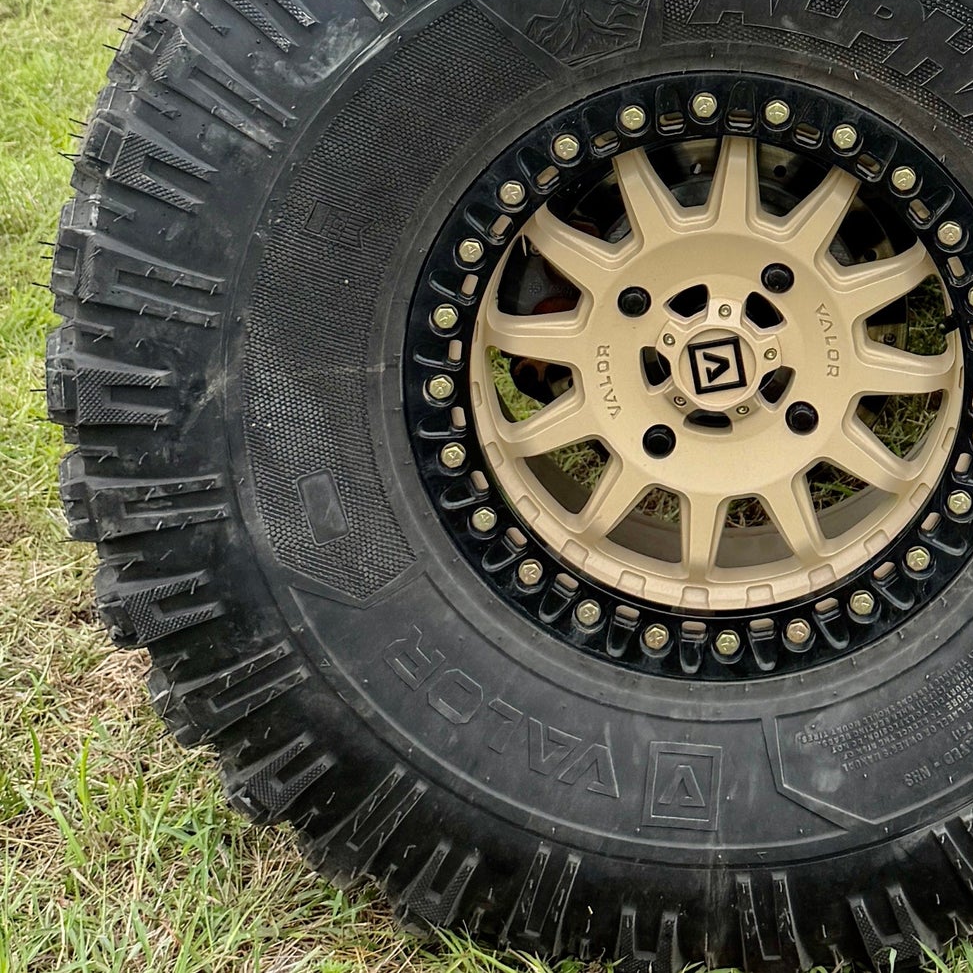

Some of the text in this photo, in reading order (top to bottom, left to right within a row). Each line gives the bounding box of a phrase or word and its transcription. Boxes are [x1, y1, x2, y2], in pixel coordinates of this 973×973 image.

[815, 302, 840, 379] VALOR
[595, 344, 622, 420] VALOR
[383, 624, 620, 799] VALOR
[901, 763, 932, 788] NHS
